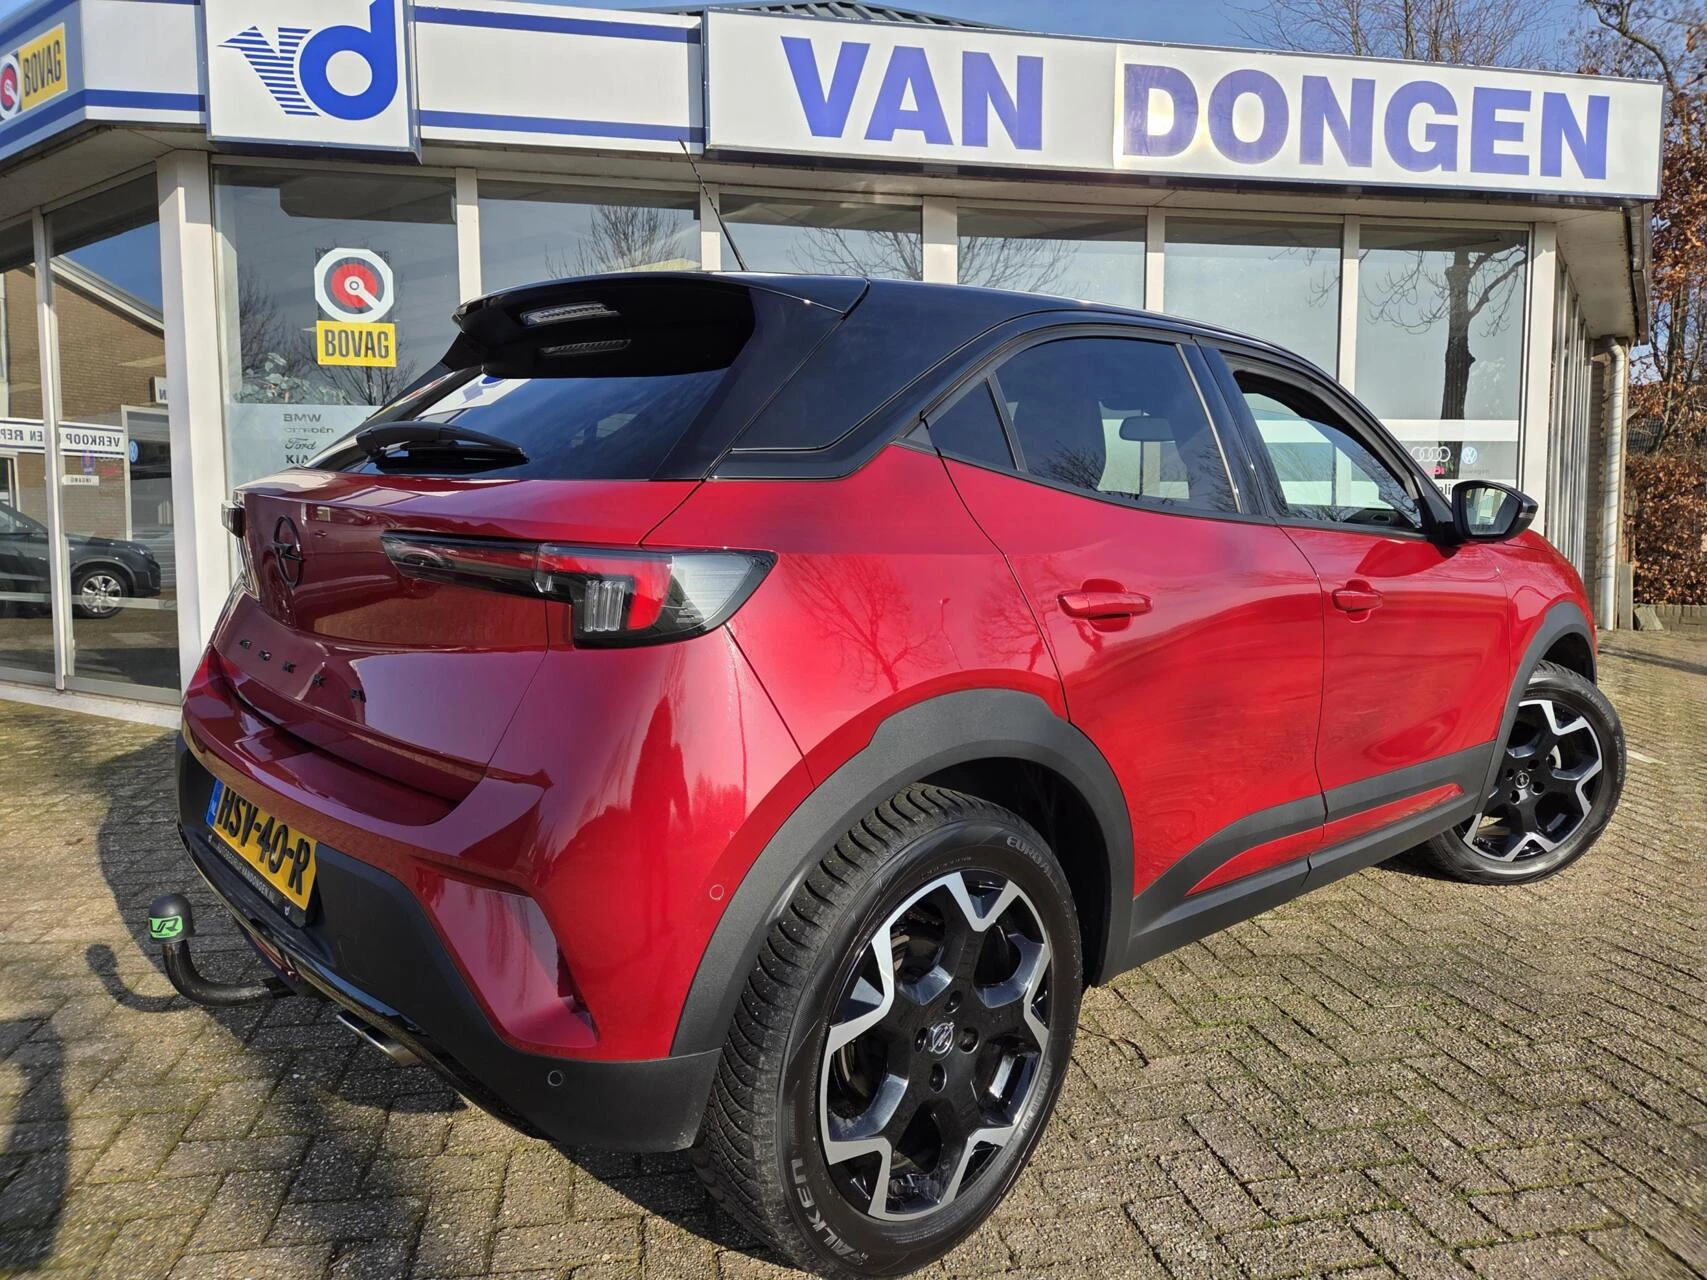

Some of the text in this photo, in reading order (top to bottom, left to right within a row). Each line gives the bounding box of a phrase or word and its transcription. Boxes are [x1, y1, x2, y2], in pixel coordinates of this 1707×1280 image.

[23, 40, 62, 97] BOVAG
[780, 36, 1611, 180] VAN DONGEN
[324, 328, 390, 359] BOVAG
[283, 413, 322, 422] BMW
[284, 437, 317, 450] Ford
[217, 787, 311, 896] HSV-40-R
